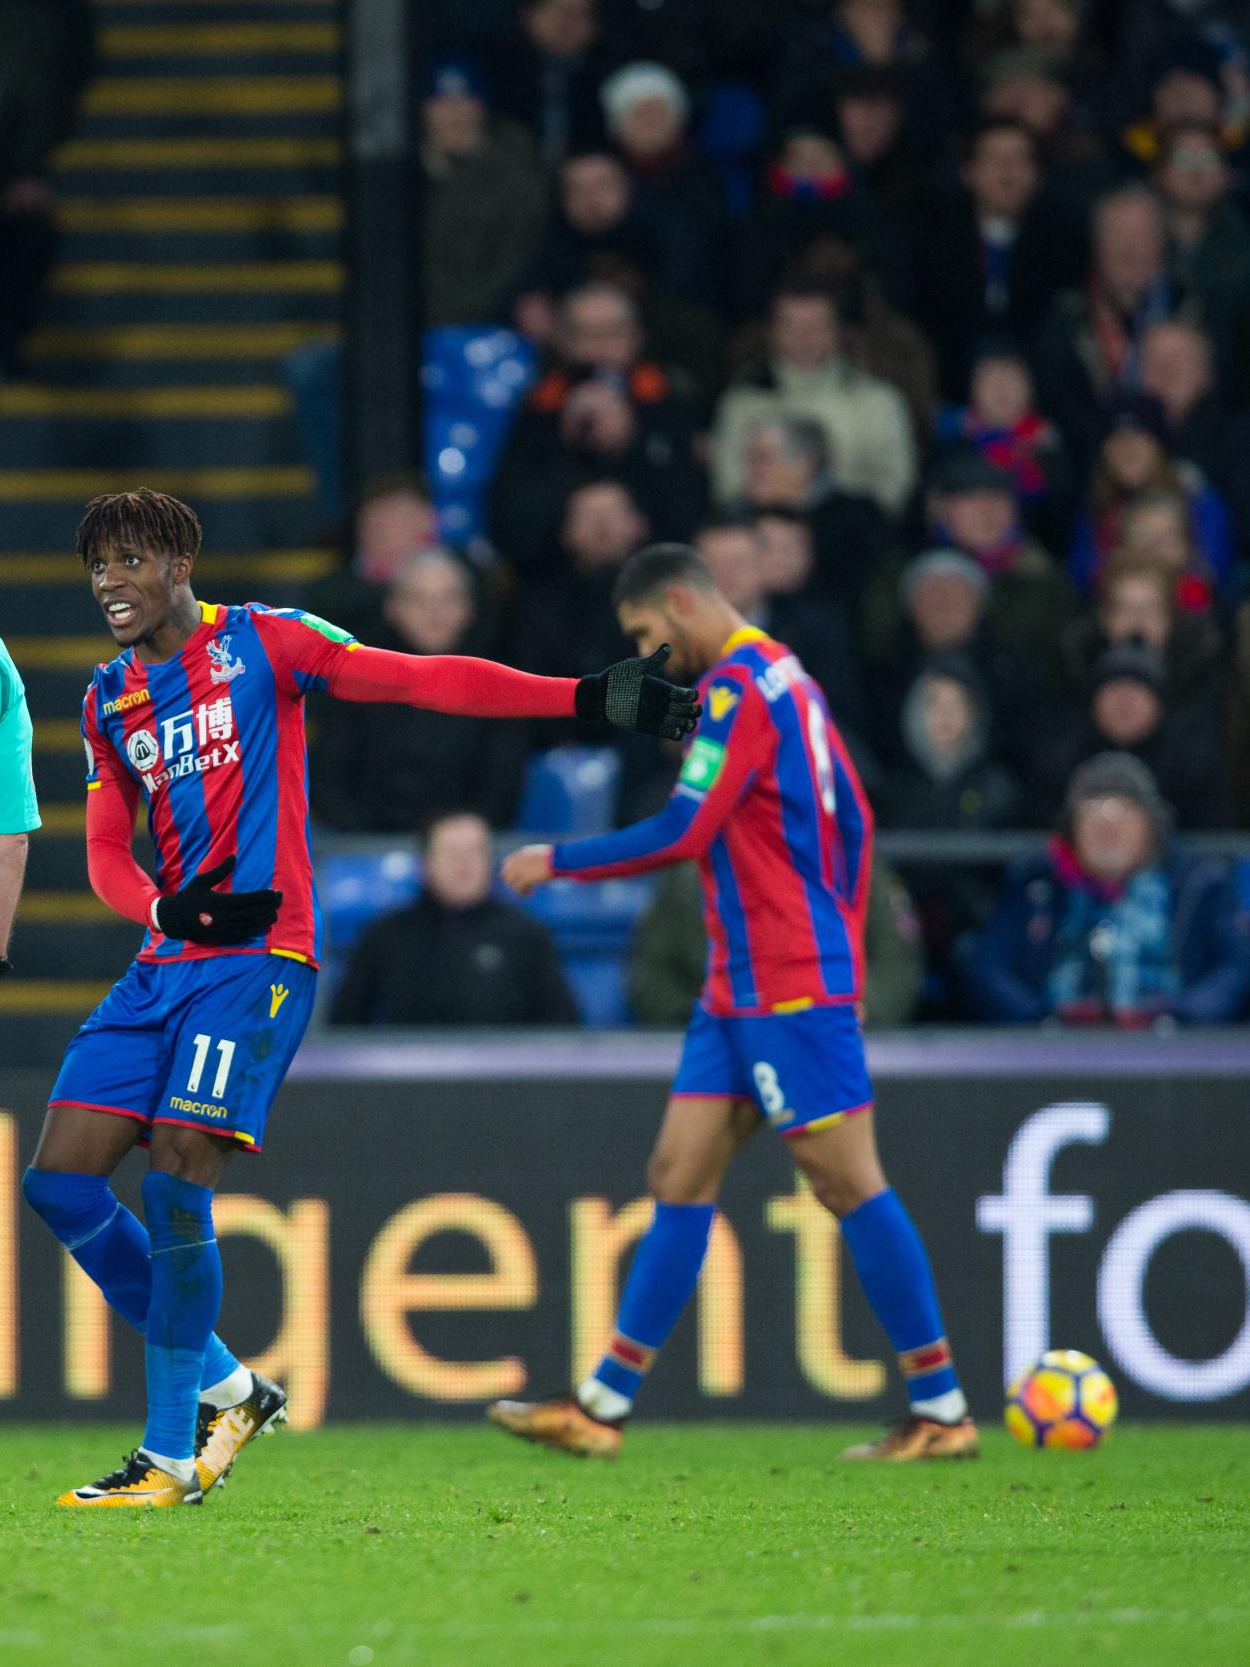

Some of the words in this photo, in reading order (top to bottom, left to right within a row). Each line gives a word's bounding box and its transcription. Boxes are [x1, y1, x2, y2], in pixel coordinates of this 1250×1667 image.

[103, 689, 150, 715] macron
[160, 697, 233, 761] 万博
[142, 741, 240, 794] ManBetX
[187, 1033, 237, 1099] 11
[169, 1096, 228, 1118] macron
